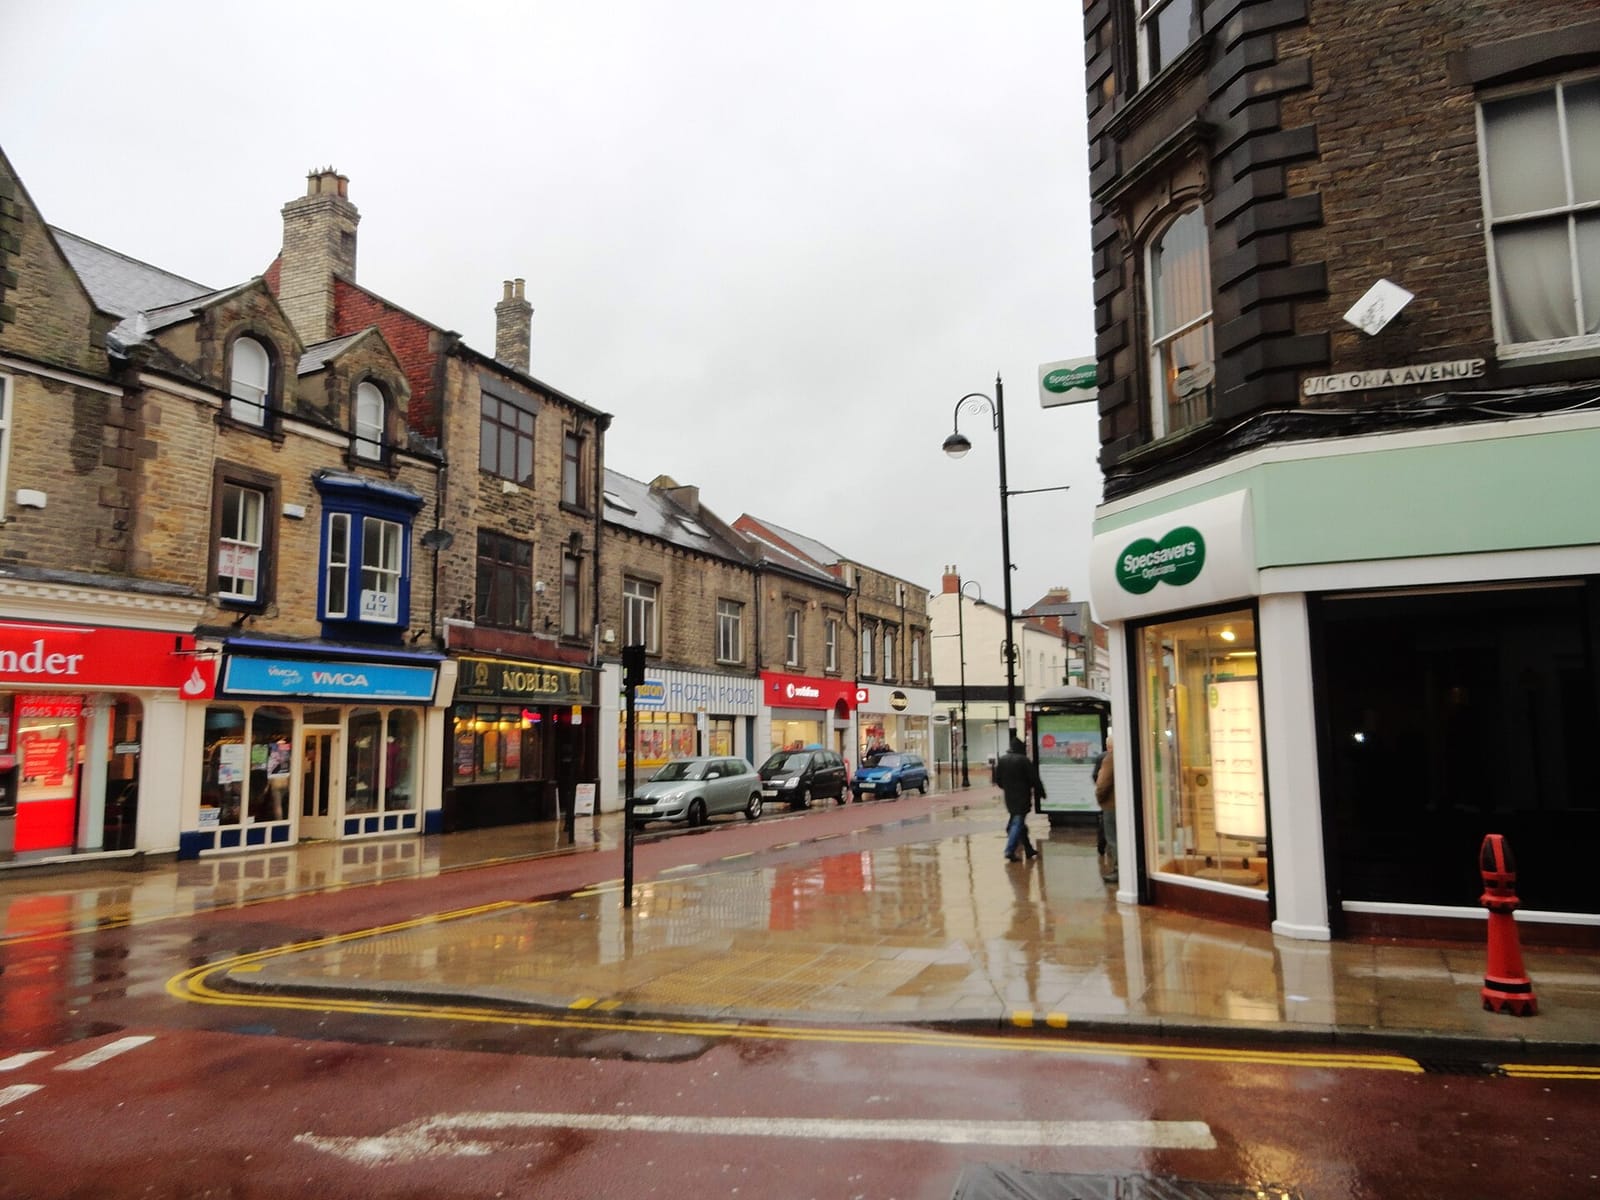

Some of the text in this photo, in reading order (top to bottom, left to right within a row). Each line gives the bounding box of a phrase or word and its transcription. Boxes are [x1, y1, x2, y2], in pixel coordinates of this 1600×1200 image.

[1403, 360, 1484, 384] AVENUE
[1123, 541, 1196, 573] Specsavers
[370, 594, 387, 603] TO
[312, 671, 368, 687] YMCA
[502, 670, 558, 693] NOBLES
[671, 682, 753, 704] FROZEN FOODS
